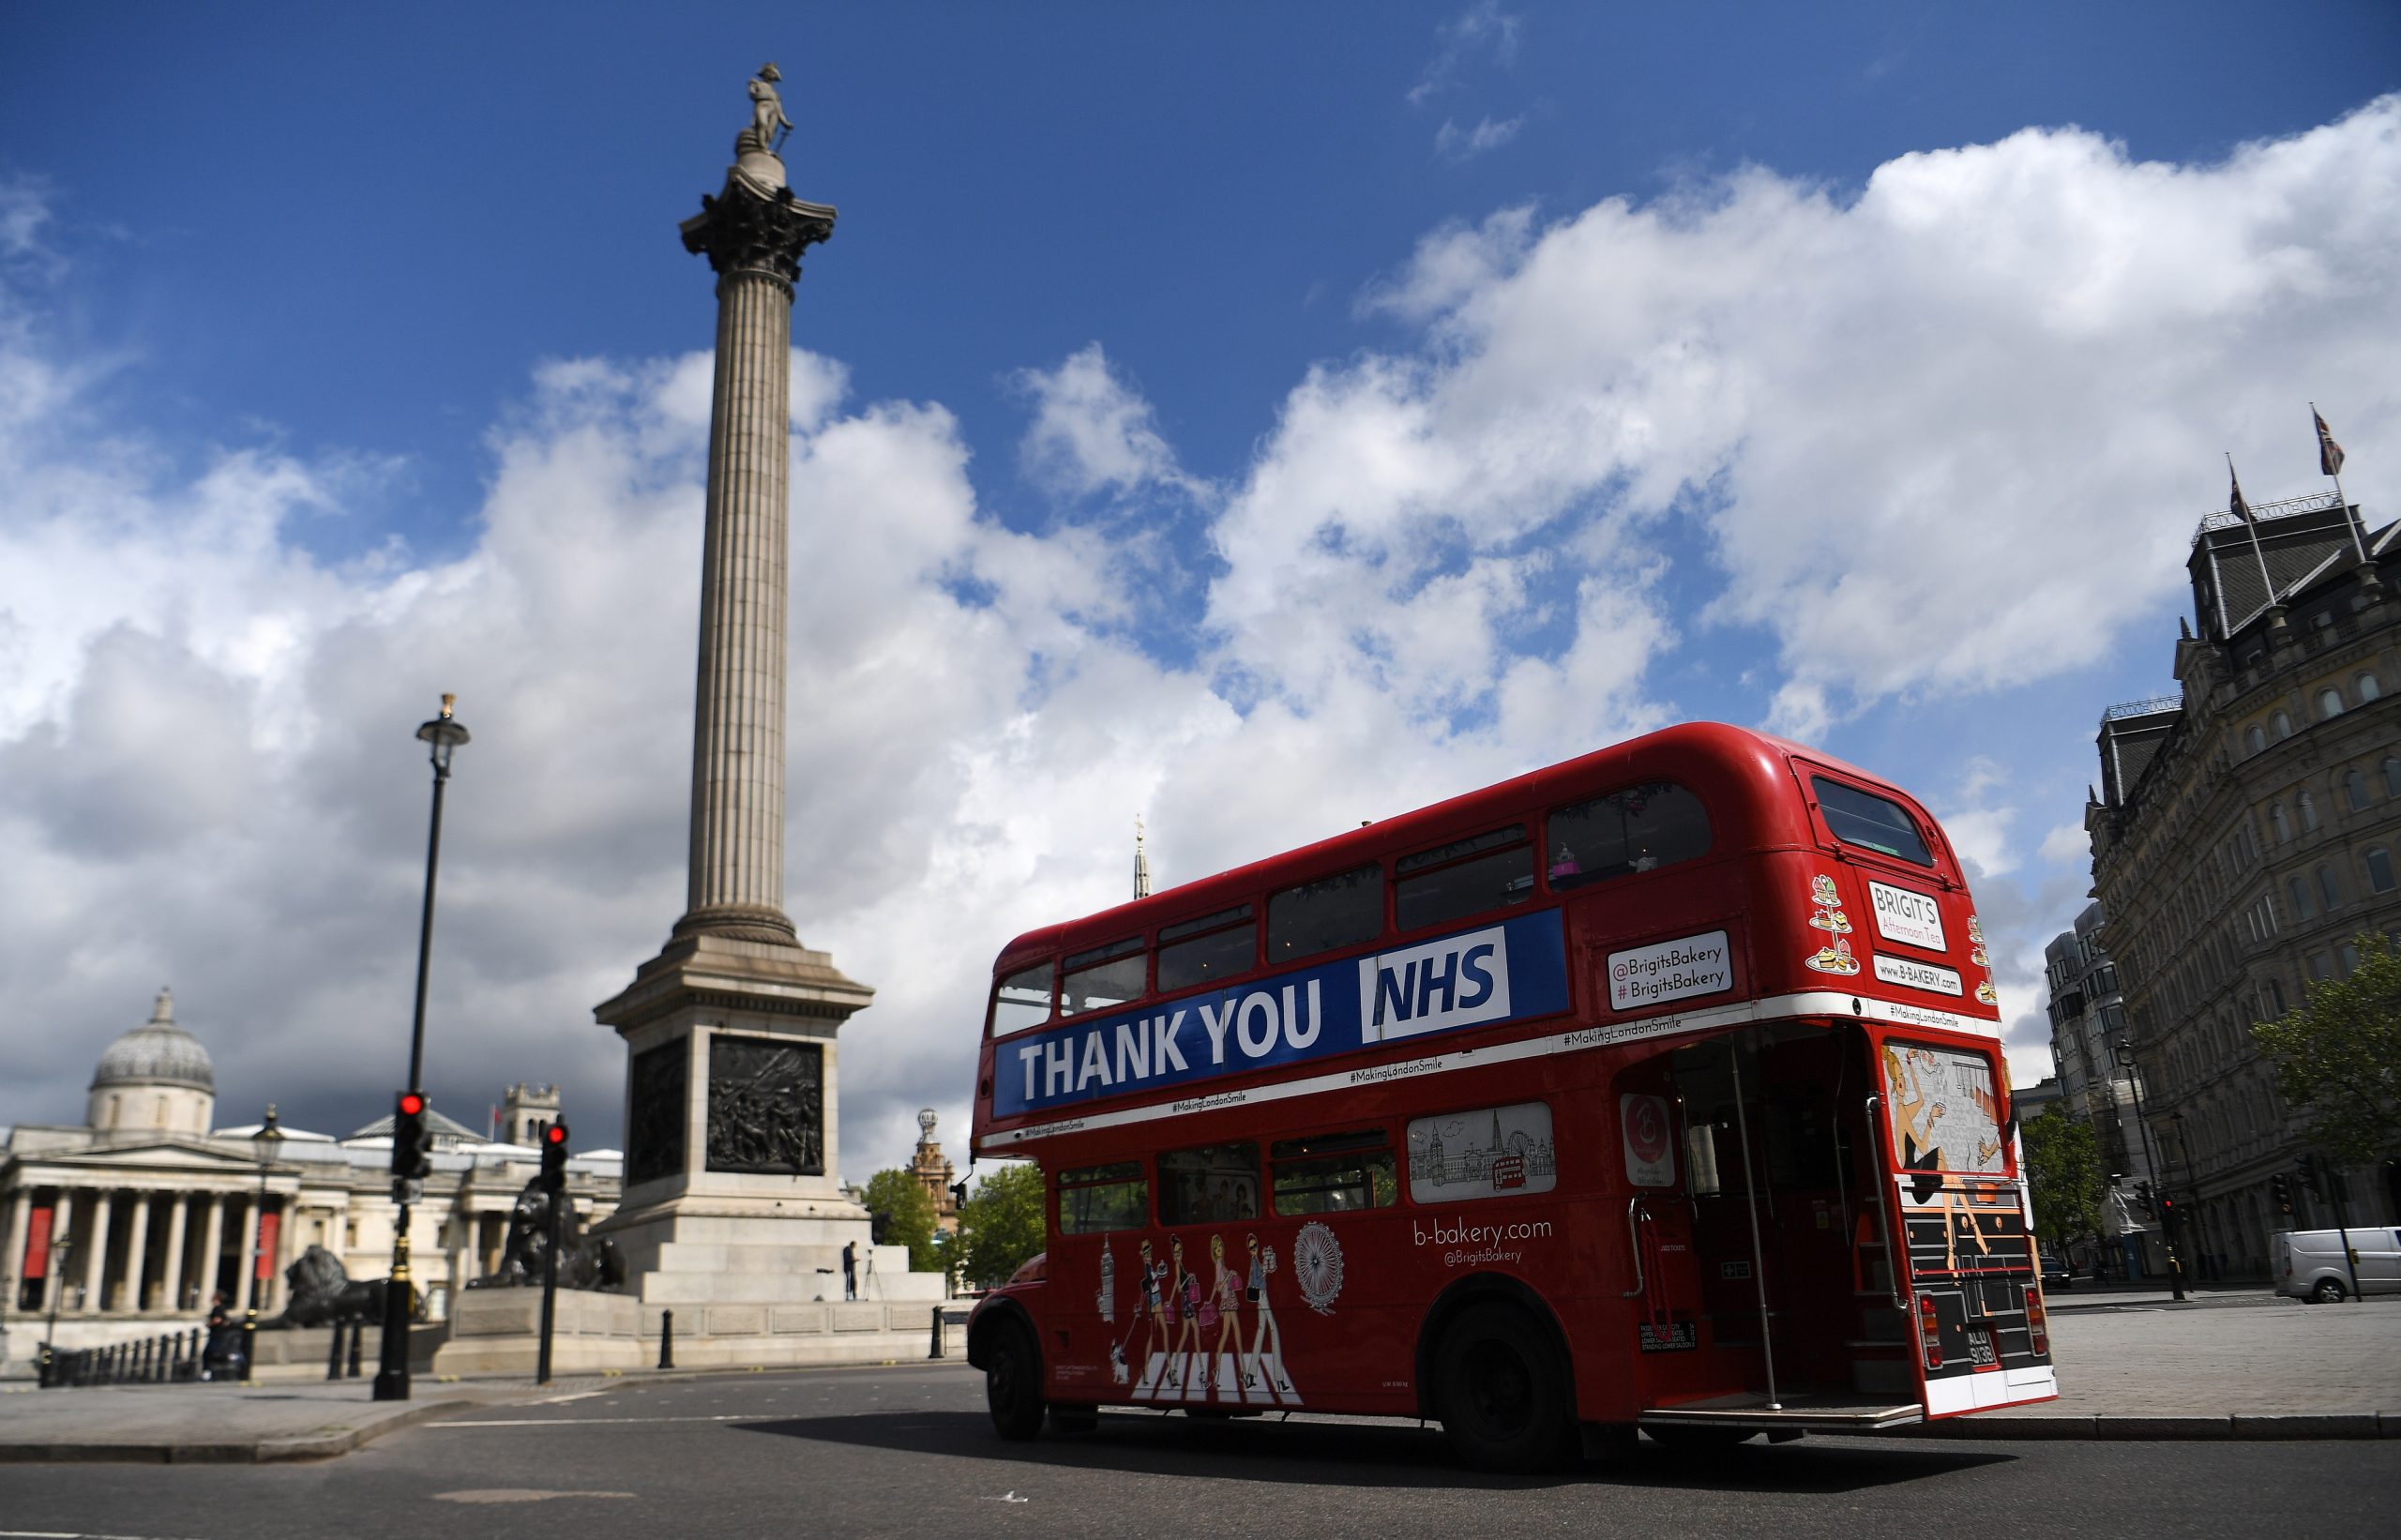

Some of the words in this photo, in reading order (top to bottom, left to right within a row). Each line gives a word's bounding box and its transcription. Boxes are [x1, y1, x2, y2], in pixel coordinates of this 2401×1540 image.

[1876, 887, 1937, 924] BRIGIT'S
[1883, 916, 1924, 940] Afternoon
[1925, 927, 1941, 944] Tea
[1613, 946, 1722, 982] @BrigitsBakery
[1631, 969, 1725, 999] BrigitsBakery
[1019, 1009, 1189, 1101] THANK
[1198, 978, 1321, 1064] YOU
[1372, 944, 1495, 1027] NHS
[1563, 1015, 1682, 1046] #MakingLondonSmile
[1890, 1004, 1959, 1028] #MakingLondonSmile
[1351, 1057, 1442, 1083] #MakingLondonSmile
[1172, 1091, 1246, 1112] #MakingLondonSmile
[1413, 1215, 1552, 1249] b-bakery.com
[1444, 1246, 1522, 1266] @BrigitsBakery
